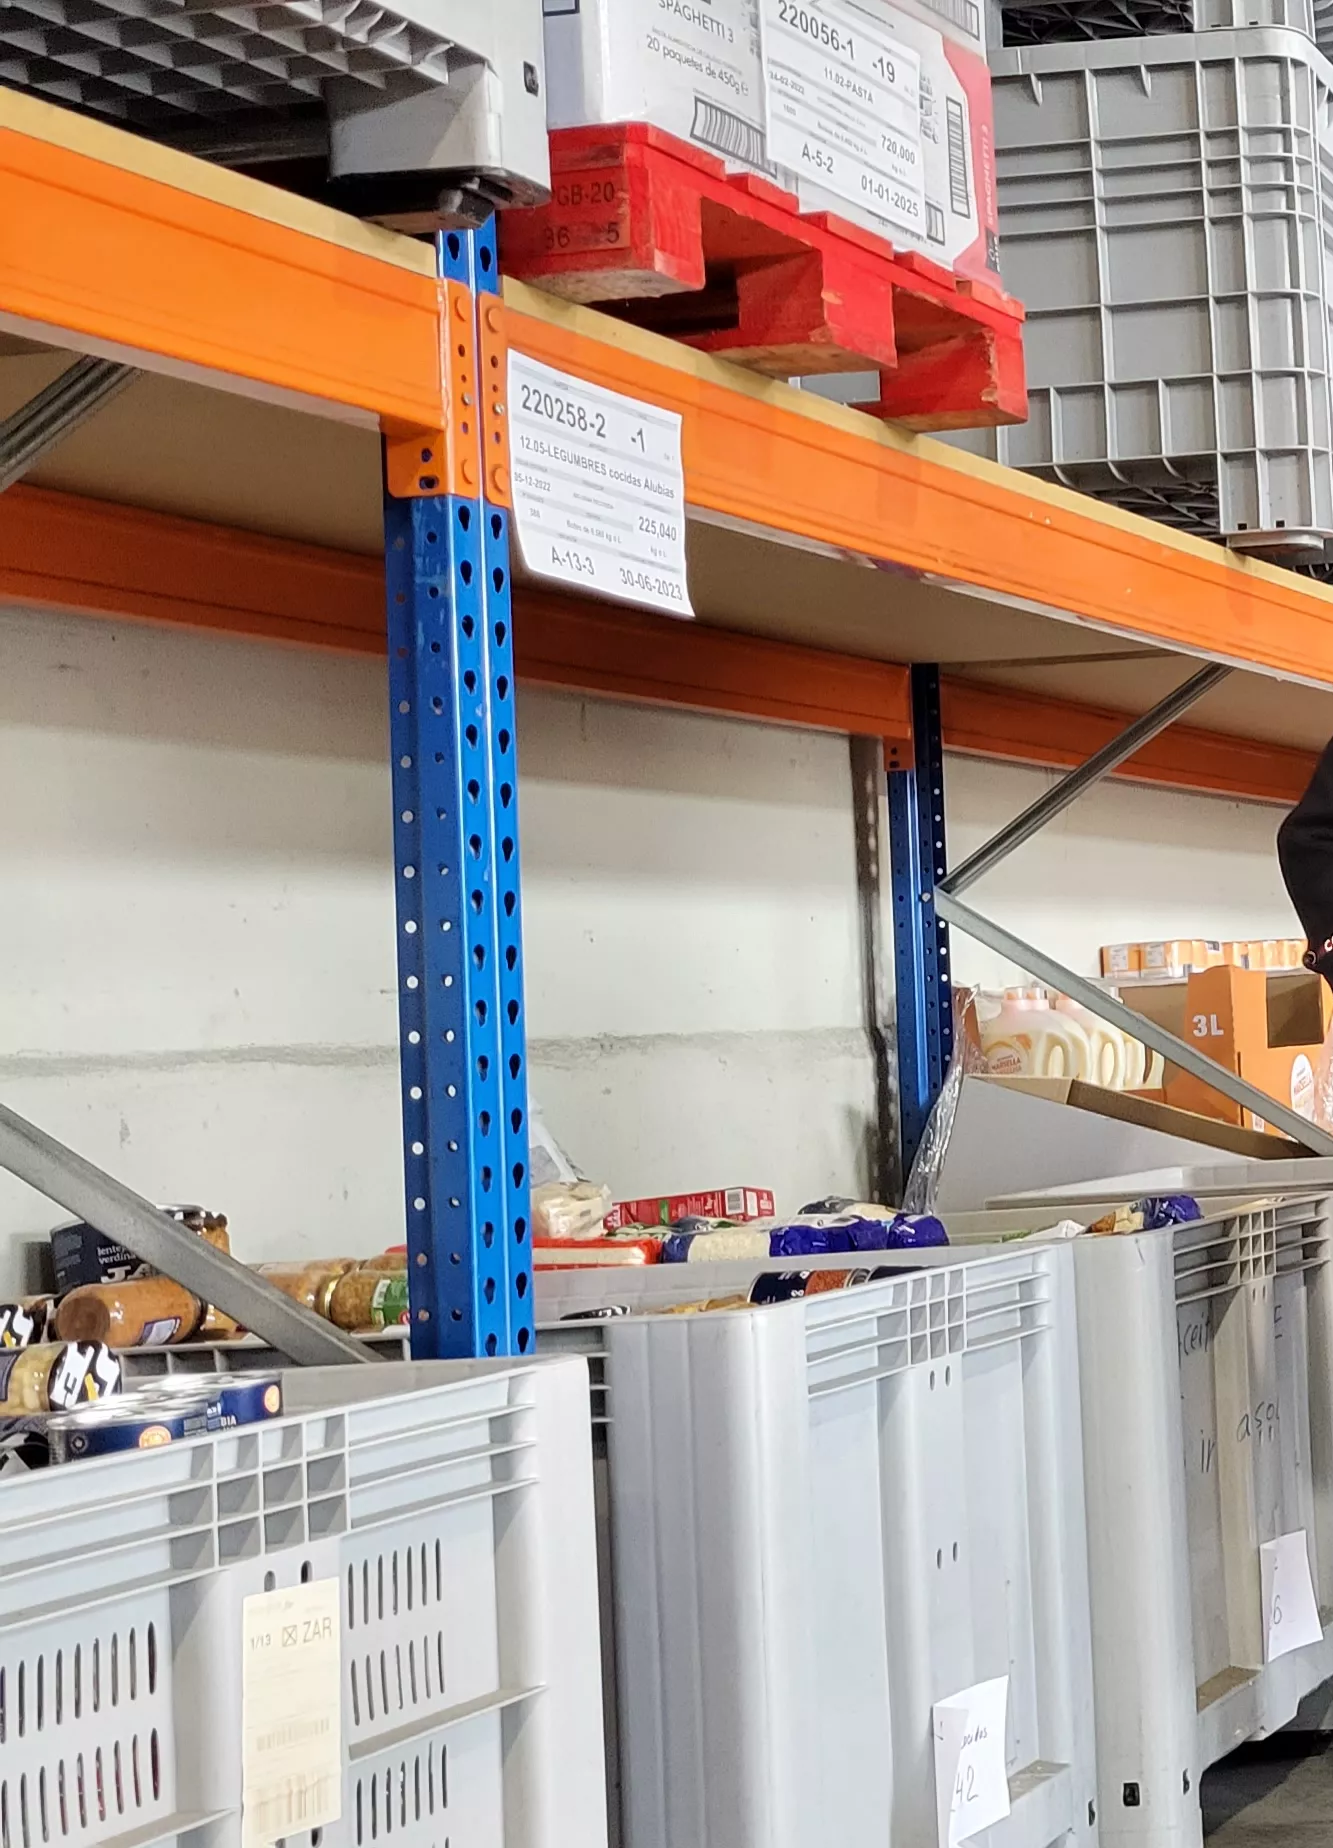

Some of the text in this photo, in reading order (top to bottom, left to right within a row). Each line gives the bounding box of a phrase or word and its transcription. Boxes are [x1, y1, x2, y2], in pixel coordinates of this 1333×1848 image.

[659, 0, 734, 43] SPAGHETTI 3
[646, 34, 660, 52] 20
[662, 46, 704, 72] paquetes
[705, 62, 717, 79] de
[779, 0, 855, 60] 220056-1
[872, 56, 896, 83] -19
[824, 67, 874, 104] 11.02-PASTA
[802, 142, 834, 174] A-5-2
[861, 174, 919, 217] 01-01-2025
[521, 384, 646, 453] 220258-2 -1
[519, 435, 607, 476] 12.05-LEGUMBRES
[609, 467, 642, 489] cocidas
[644, 478, 675, 500] Alubias
[638, 515, 677, 542] 225,040
[551, 546, 595, 576] A-13-3
[619, 567, 683, 601] 30-06-2023
[1192, 1013, 1225, 1038] 3L
[302, 1616, 333, 1644] ZAR
